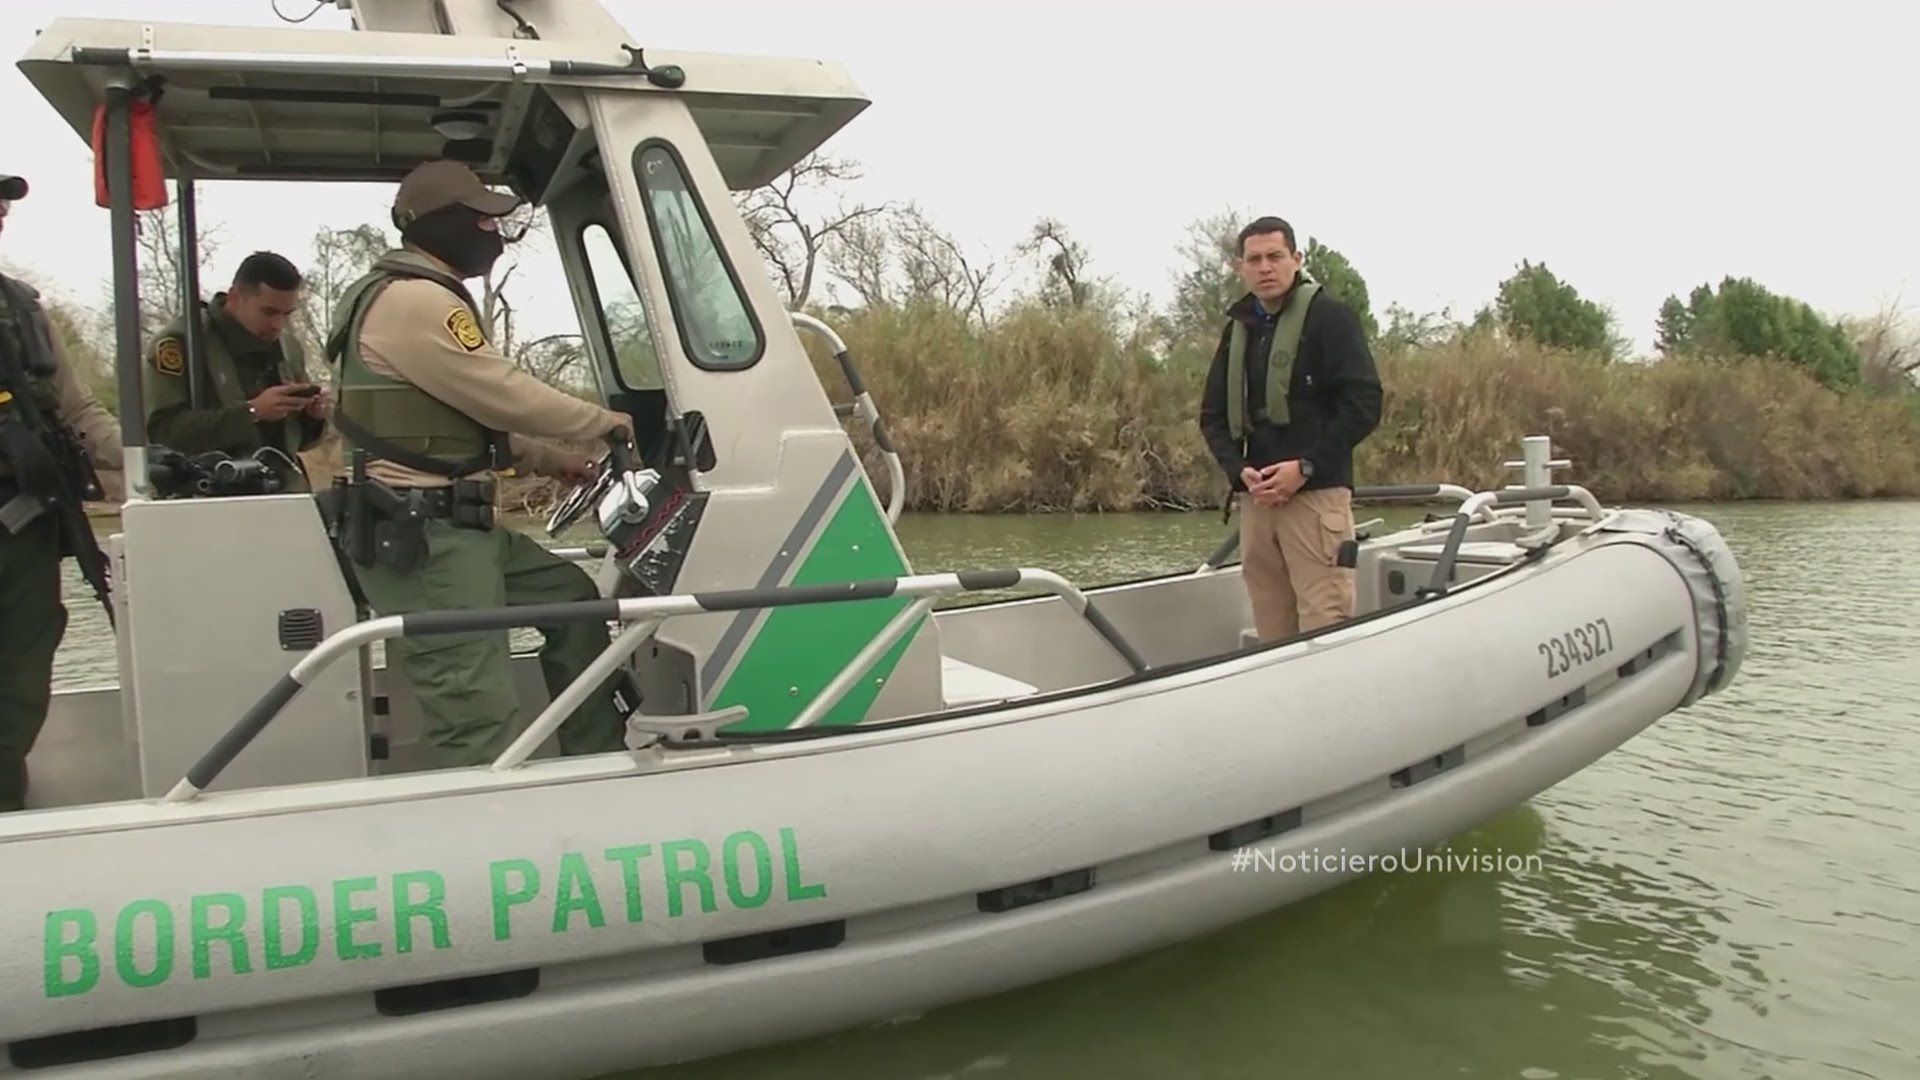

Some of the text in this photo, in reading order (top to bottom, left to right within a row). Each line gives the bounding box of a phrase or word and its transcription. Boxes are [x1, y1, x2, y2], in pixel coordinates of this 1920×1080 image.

[1537, 617, 1613, 679] 234327
[43, 827, 827, 998] BORDER PATROL
